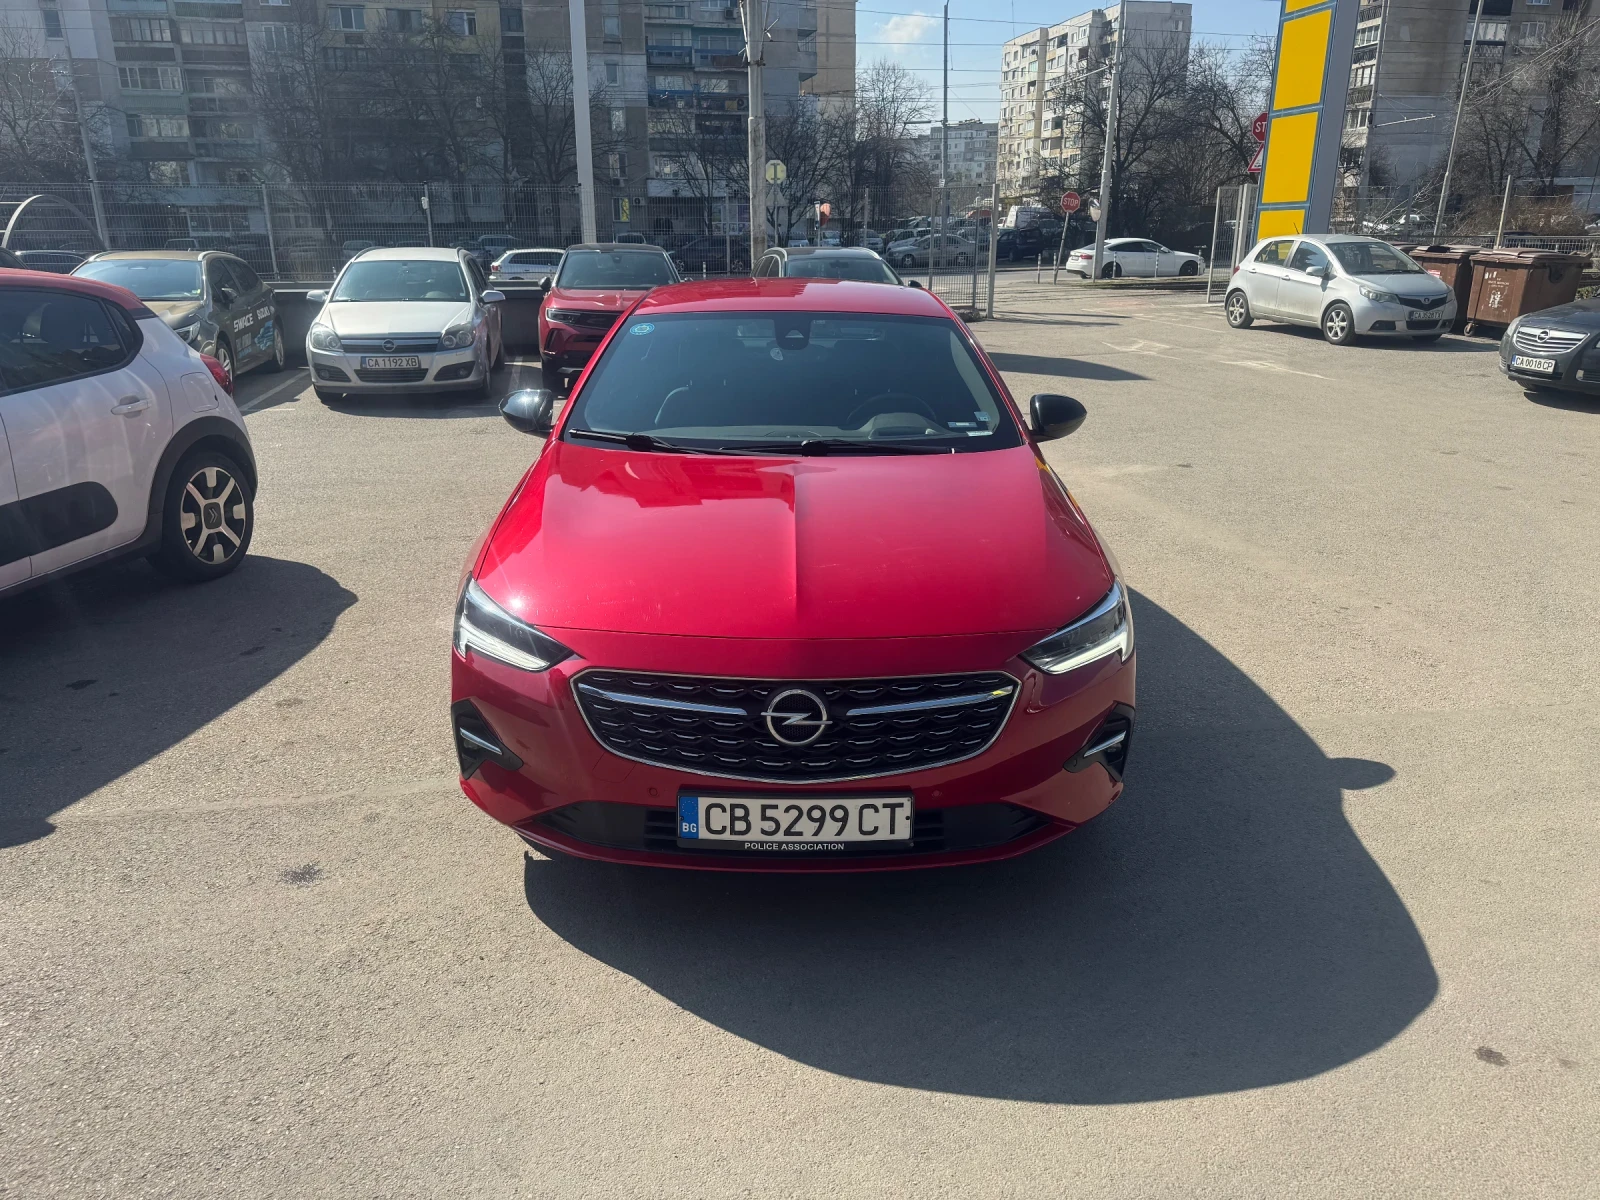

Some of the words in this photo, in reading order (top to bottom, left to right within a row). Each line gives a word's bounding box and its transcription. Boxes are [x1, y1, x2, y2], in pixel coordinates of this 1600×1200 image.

[1255, 121, 1267, 132] ST
[1063, 197, 1079, 206] STOP
[233, 313, 254, 332] SWACE
[367, 358, 380, 367] CA
[382, 358, 403, 367] 1192
[404, 358, 418, 367] XB
[1515, 357, 1524, 366] CA
[1525, 359, 1542, 369] 0018
[1543, 361, 1553, 370] CP
[705, 803, 751, 835] CB
[760, 804, 849, 837] 5299
[858, 802, 904, 835] CT
[682, 822, 697, 833] BG
[744, 842, 779, 850] POLICE
[780, 843, 845, 851] ASSOCIATION
